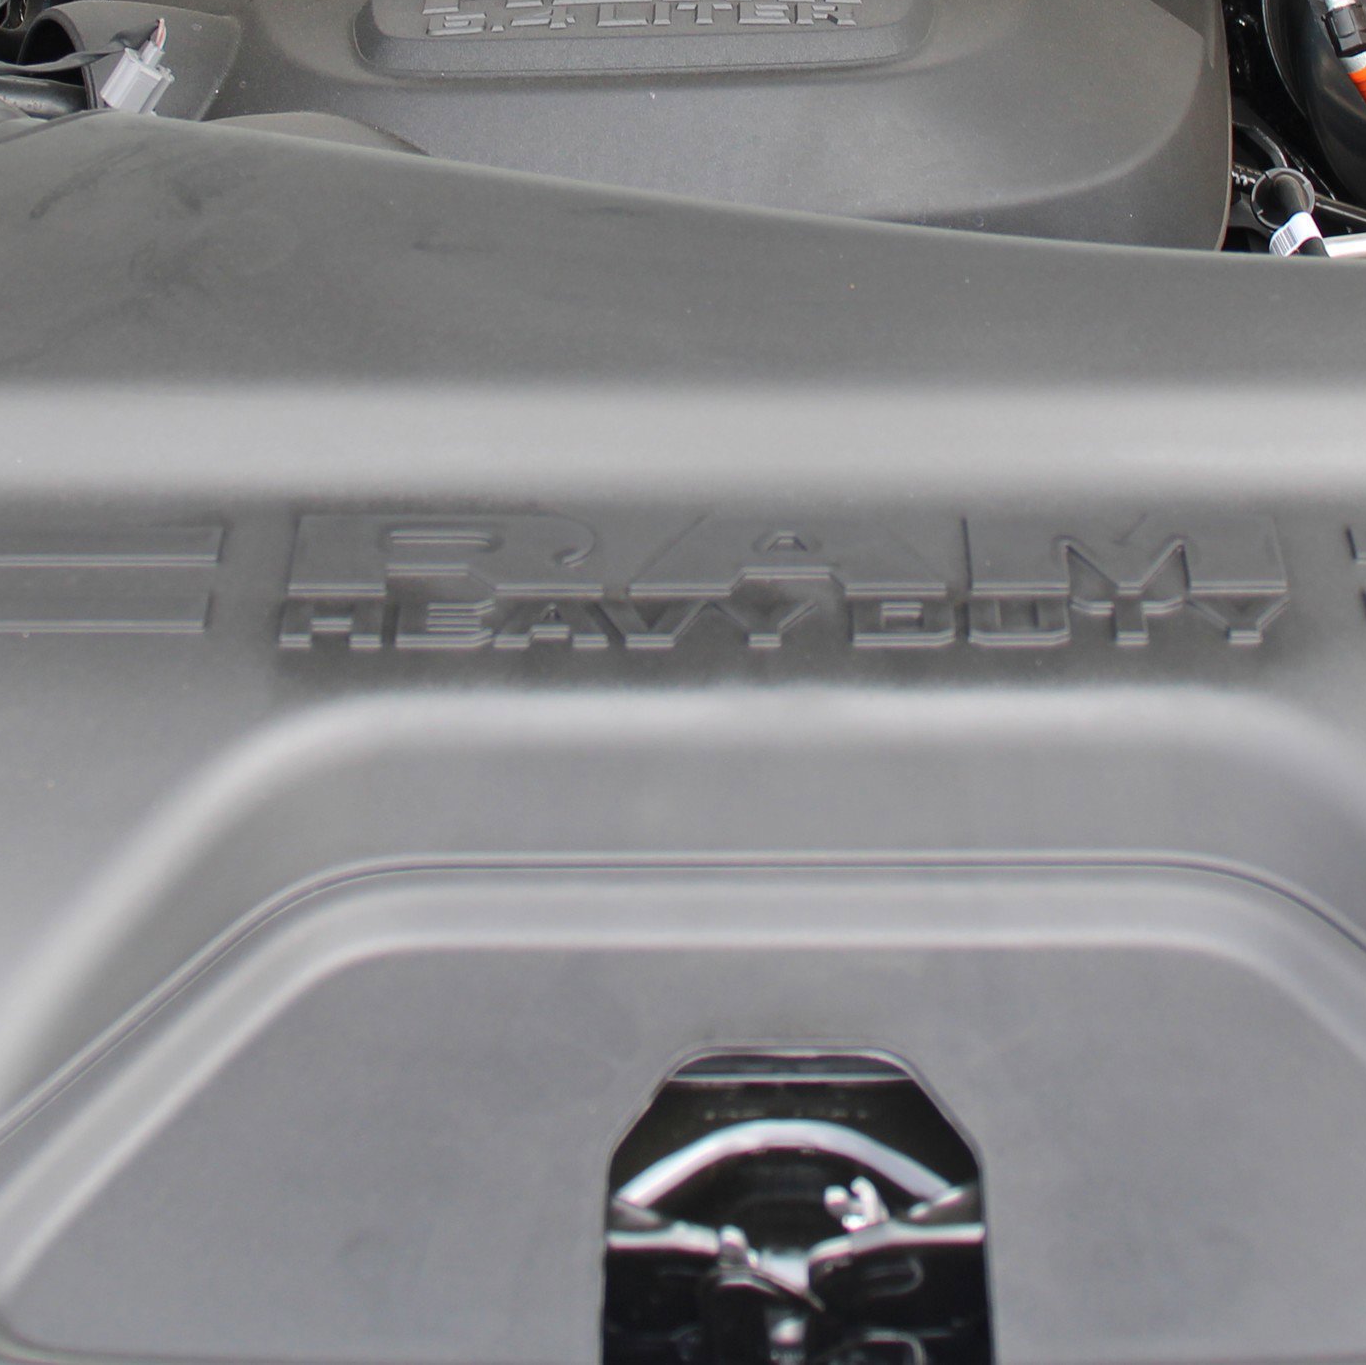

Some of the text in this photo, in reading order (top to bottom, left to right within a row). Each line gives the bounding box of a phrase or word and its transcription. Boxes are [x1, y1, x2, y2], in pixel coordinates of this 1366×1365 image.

[426, 1, 858, 37] 6.4 LITER
[286, 511, 1287, 598] RAM
[278, 595, 1290, 649] HEAVY DUTY
